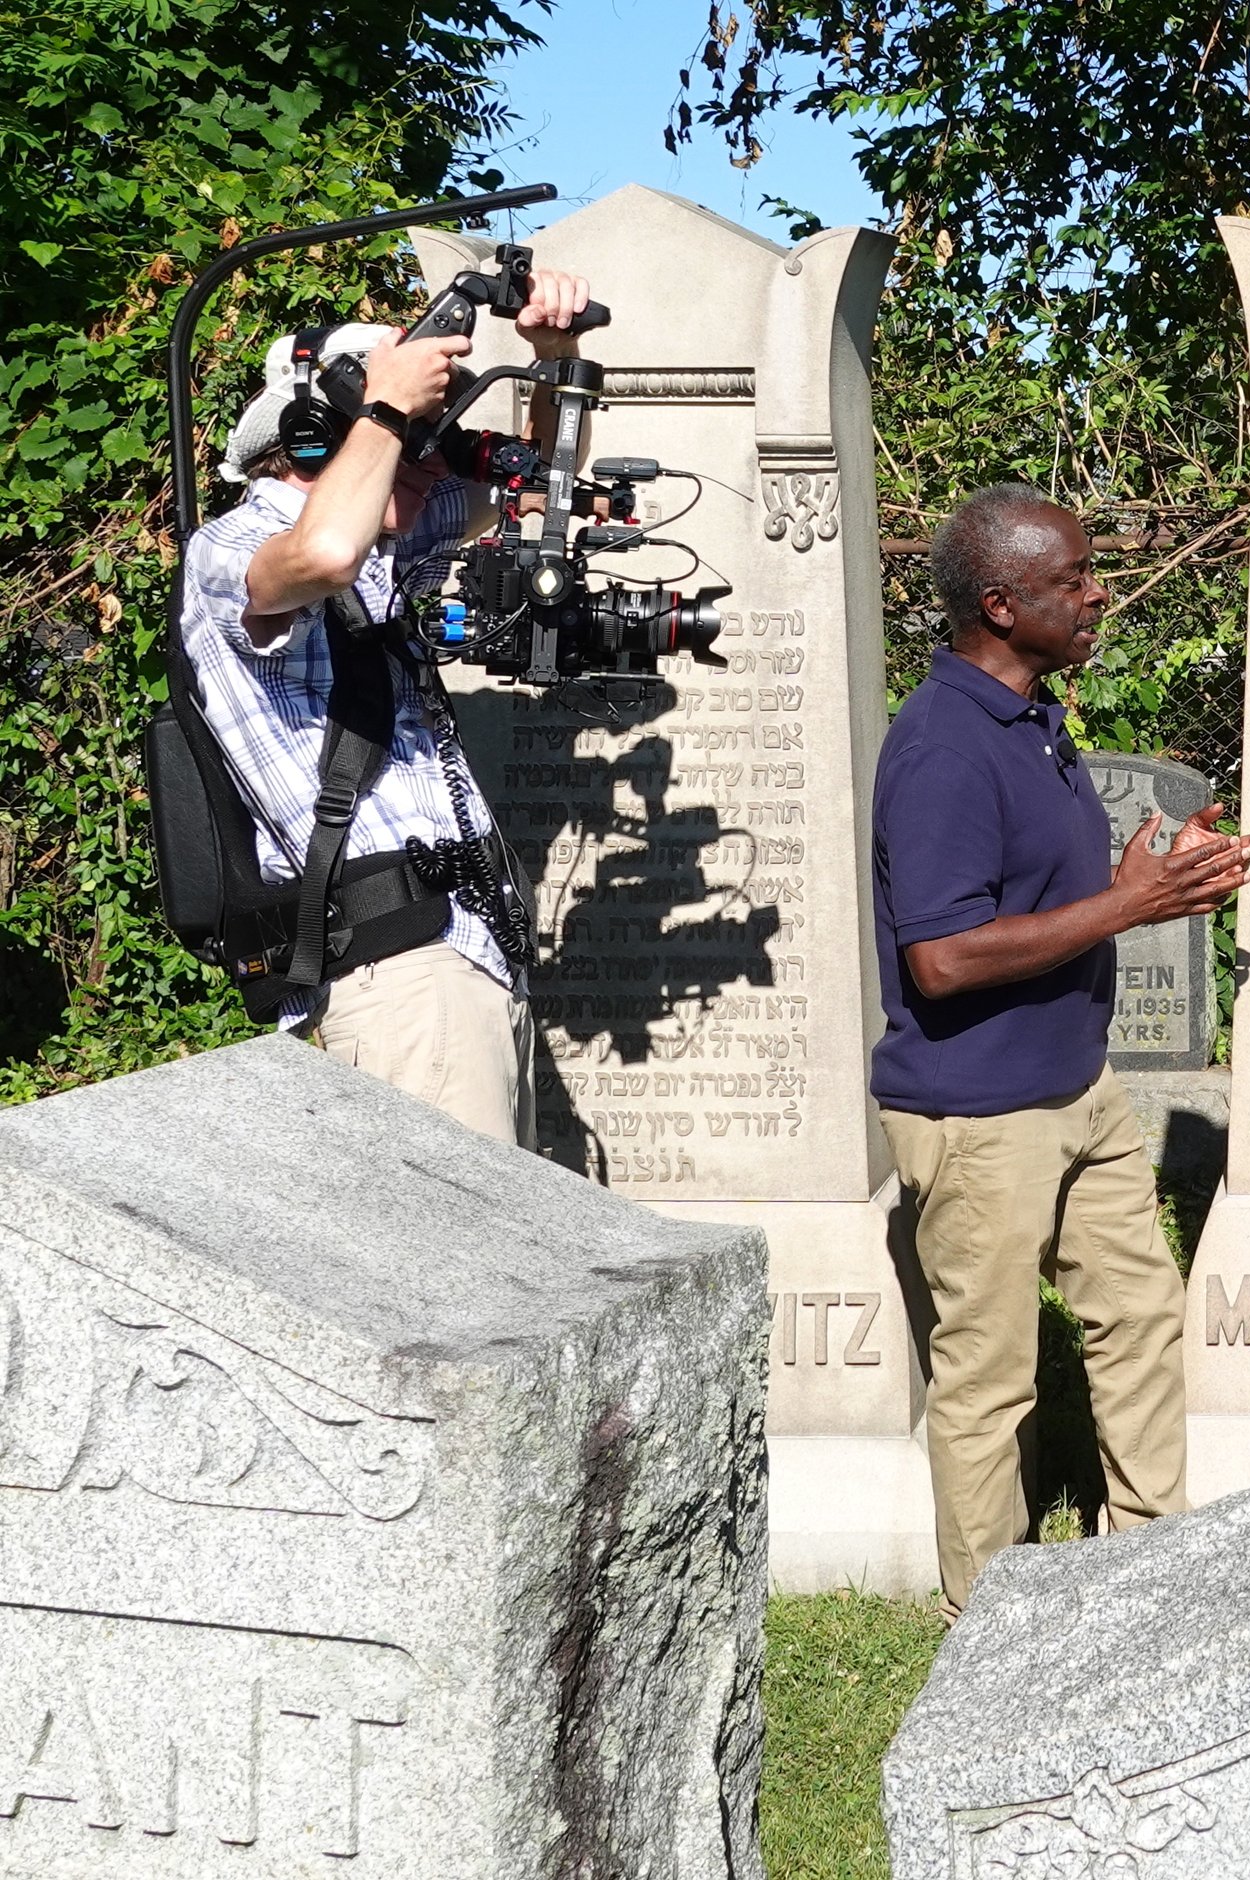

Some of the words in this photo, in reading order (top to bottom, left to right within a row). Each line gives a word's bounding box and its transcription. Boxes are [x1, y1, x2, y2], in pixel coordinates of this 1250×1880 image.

[562, 408, 576, 442] CRANE
[1136, 998, 1186, 1016] 1935
[1117, 1023, 1171, 1042] YRS.
[768, 1293, 882, 1366] ITZ
